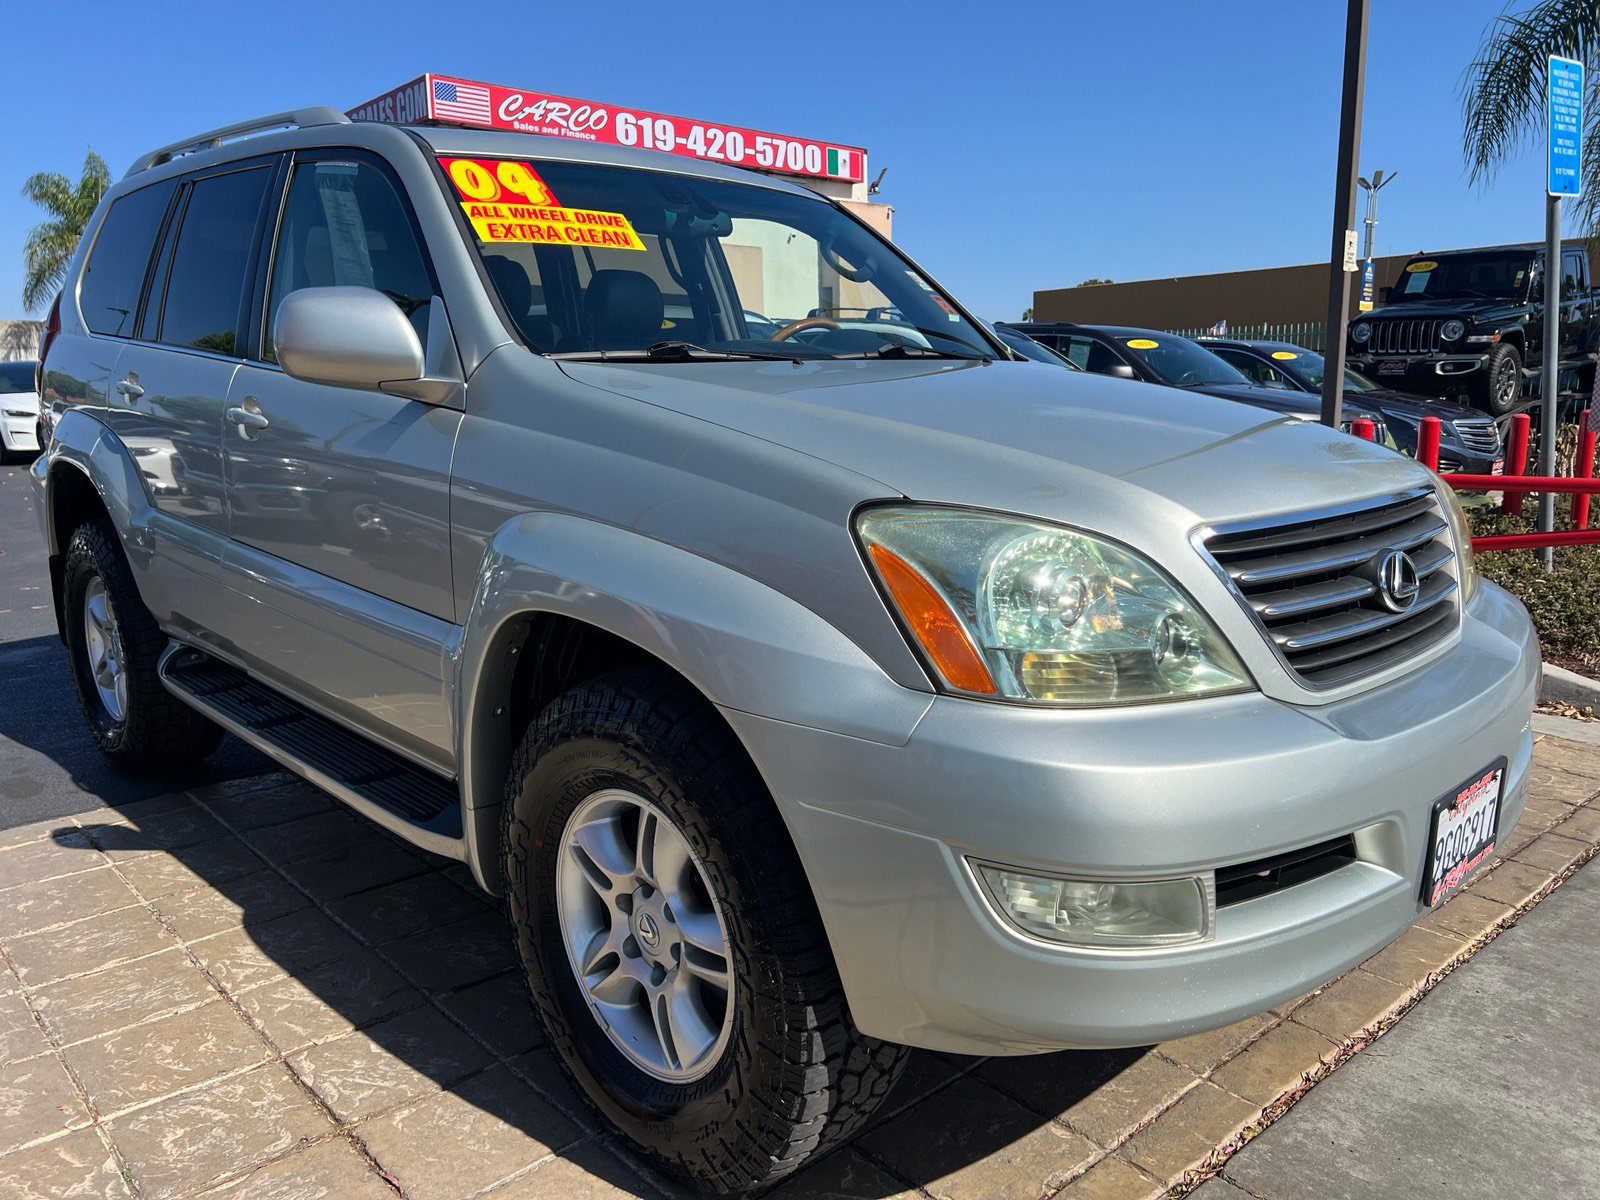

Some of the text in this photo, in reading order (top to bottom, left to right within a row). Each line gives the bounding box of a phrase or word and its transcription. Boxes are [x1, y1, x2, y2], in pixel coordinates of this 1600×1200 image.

[498, 93, 609, 132] CARCO
[513, 121, 596, 141] Sales and Finance
[614, 110, 822, 175] 619-420-5700
[449, 159, 553, 206] 04
[470, 205, 625, 228] ALL WHEEL DRIVE
[487, 222, 633, 247] EXTRA CLEAN
